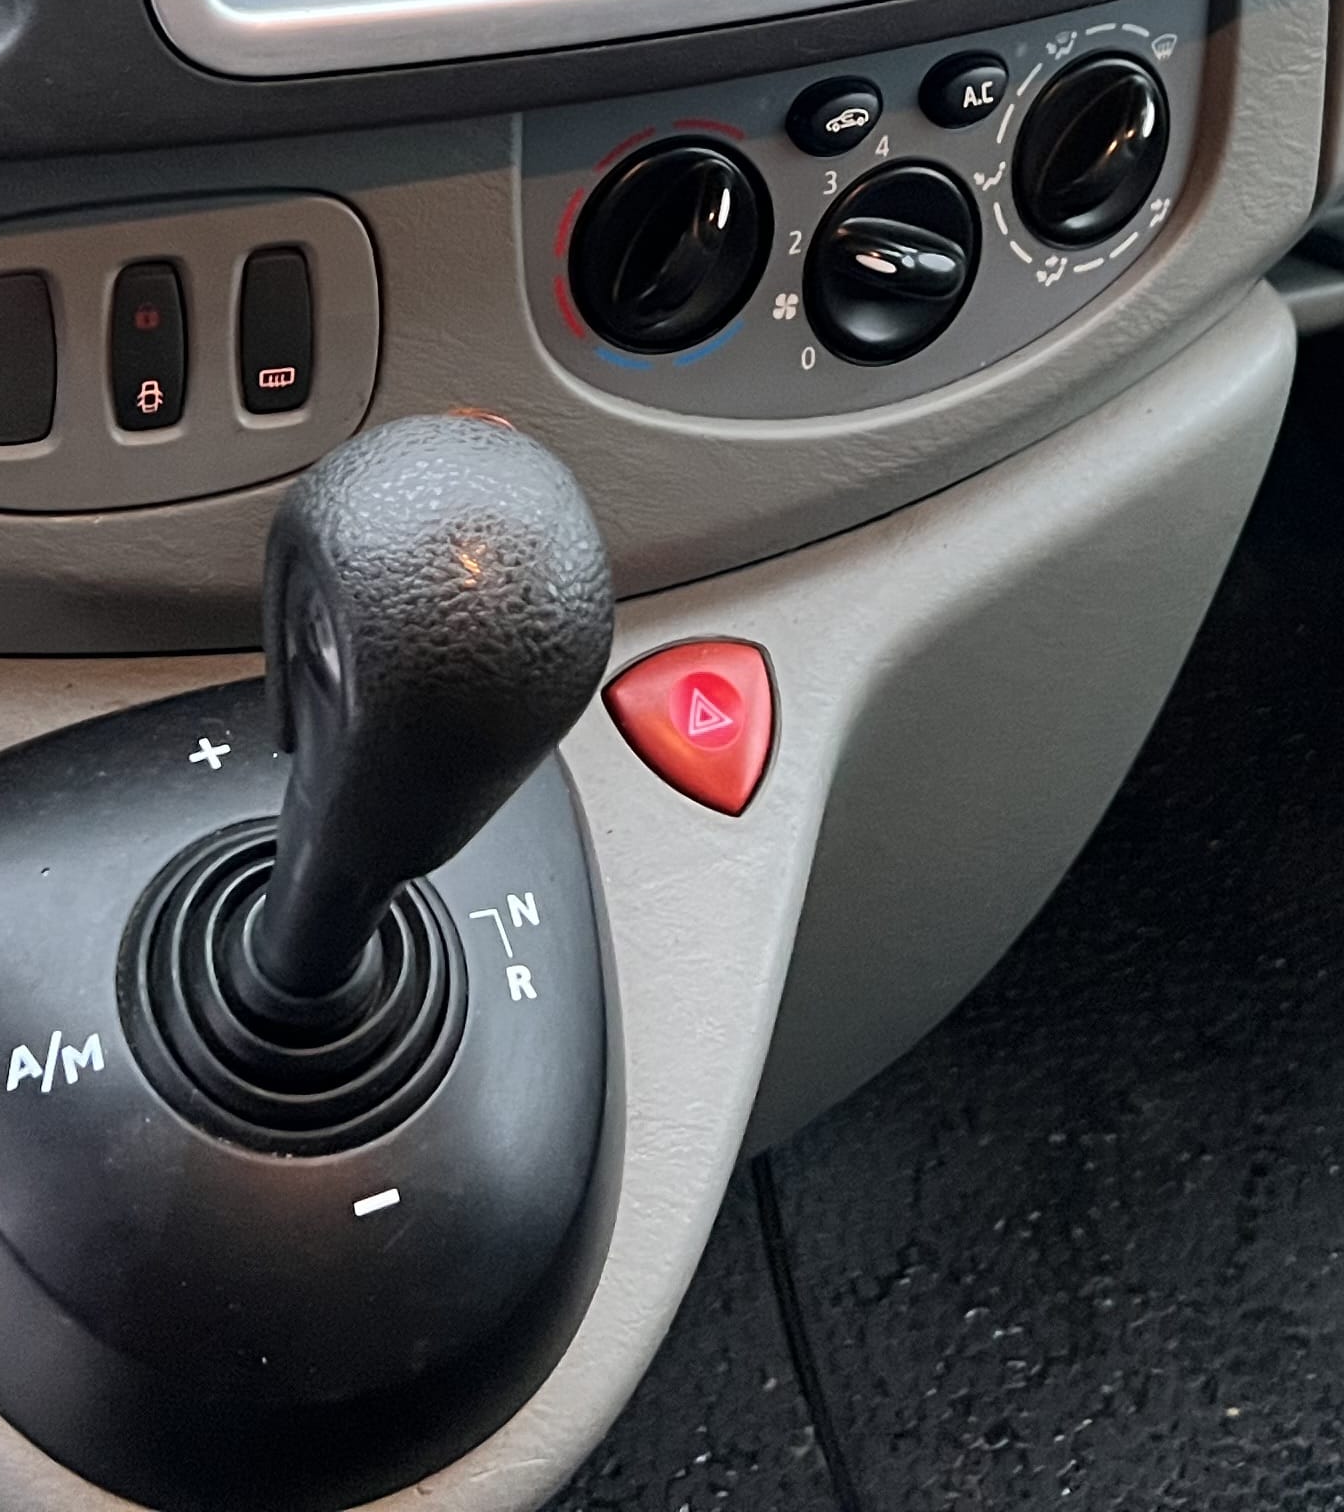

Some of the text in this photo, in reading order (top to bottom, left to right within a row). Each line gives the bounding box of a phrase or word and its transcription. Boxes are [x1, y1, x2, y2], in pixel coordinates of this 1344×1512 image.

[874, 136, 890, 157] 4
[824, 171, 838, 195] 3
[789, 231, 801, 255] 2
[801, 347, 815, 371] 0
[507, 892, 540, 928] N
[505, 964, 537, 1001] R
[6, 1030, 105, 1094] A/M
